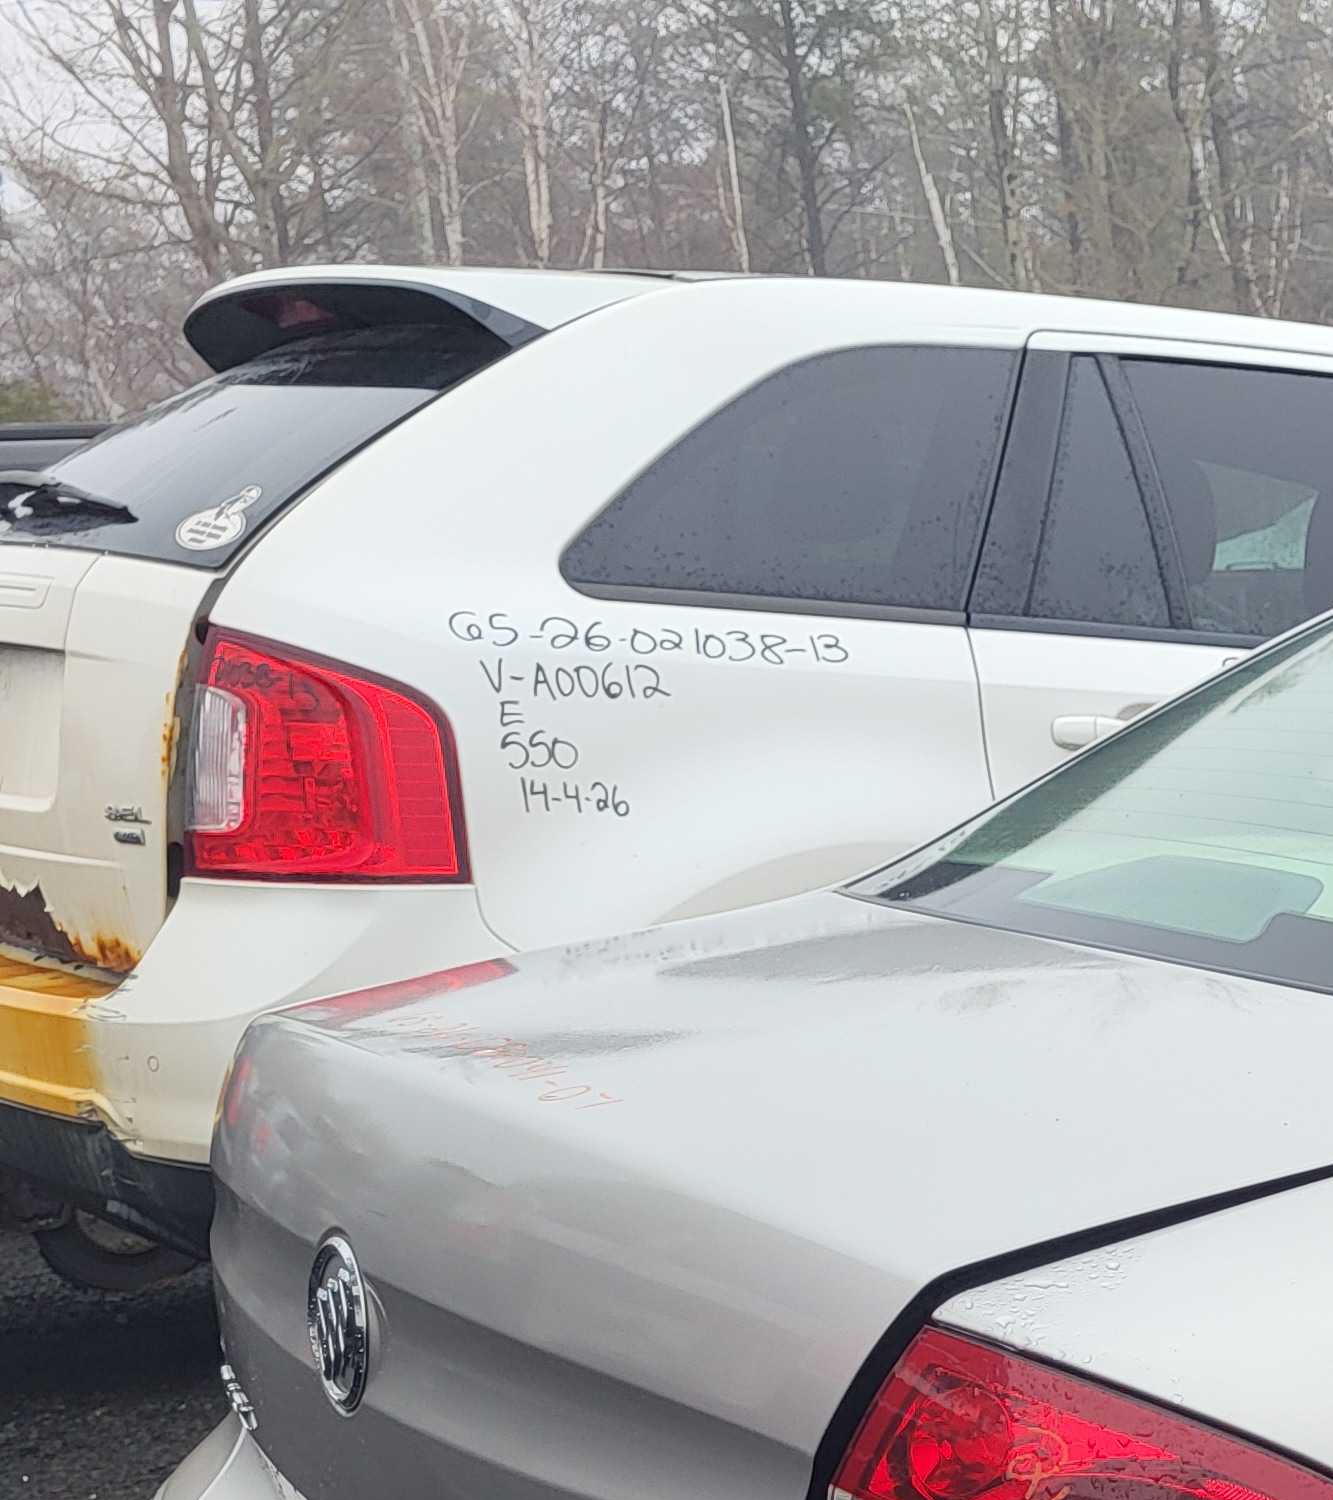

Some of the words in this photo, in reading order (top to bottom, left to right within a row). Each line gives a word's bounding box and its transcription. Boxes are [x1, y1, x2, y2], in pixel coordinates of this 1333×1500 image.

[448, 611, 849, 664] 65-26-021038-13
[480, 658, 671, 701] V-A00612
[500, 700, 525, 727] E
[500, 731, 578, 768] 550
[521, 777, 630, 817] 14-4-26
